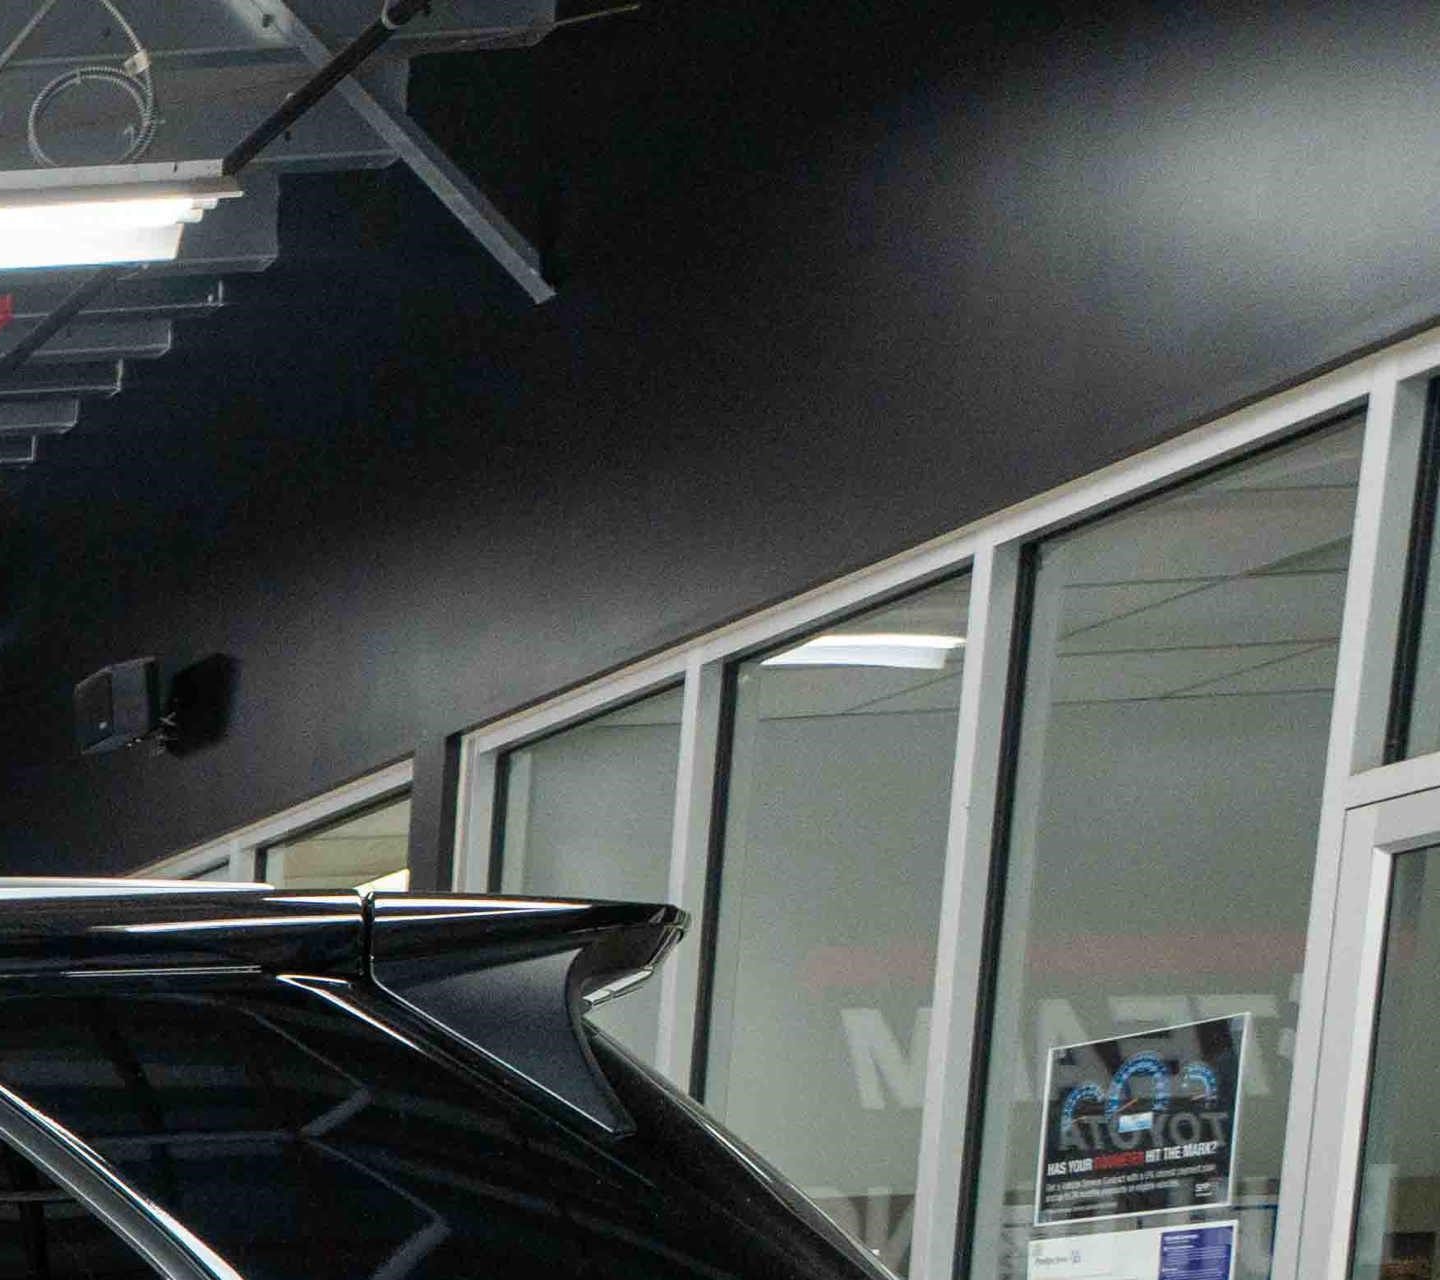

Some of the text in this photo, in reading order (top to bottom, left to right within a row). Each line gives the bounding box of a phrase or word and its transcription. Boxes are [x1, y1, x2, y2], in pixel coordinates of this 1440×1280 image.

[1047, 1162, 1067, 1177] HAS
[1068, 1158, 1093, 1172] YOUR
[1145, 1149, 1161, 1163] HIT
[1163, 1145, 1183, 1161] THE
